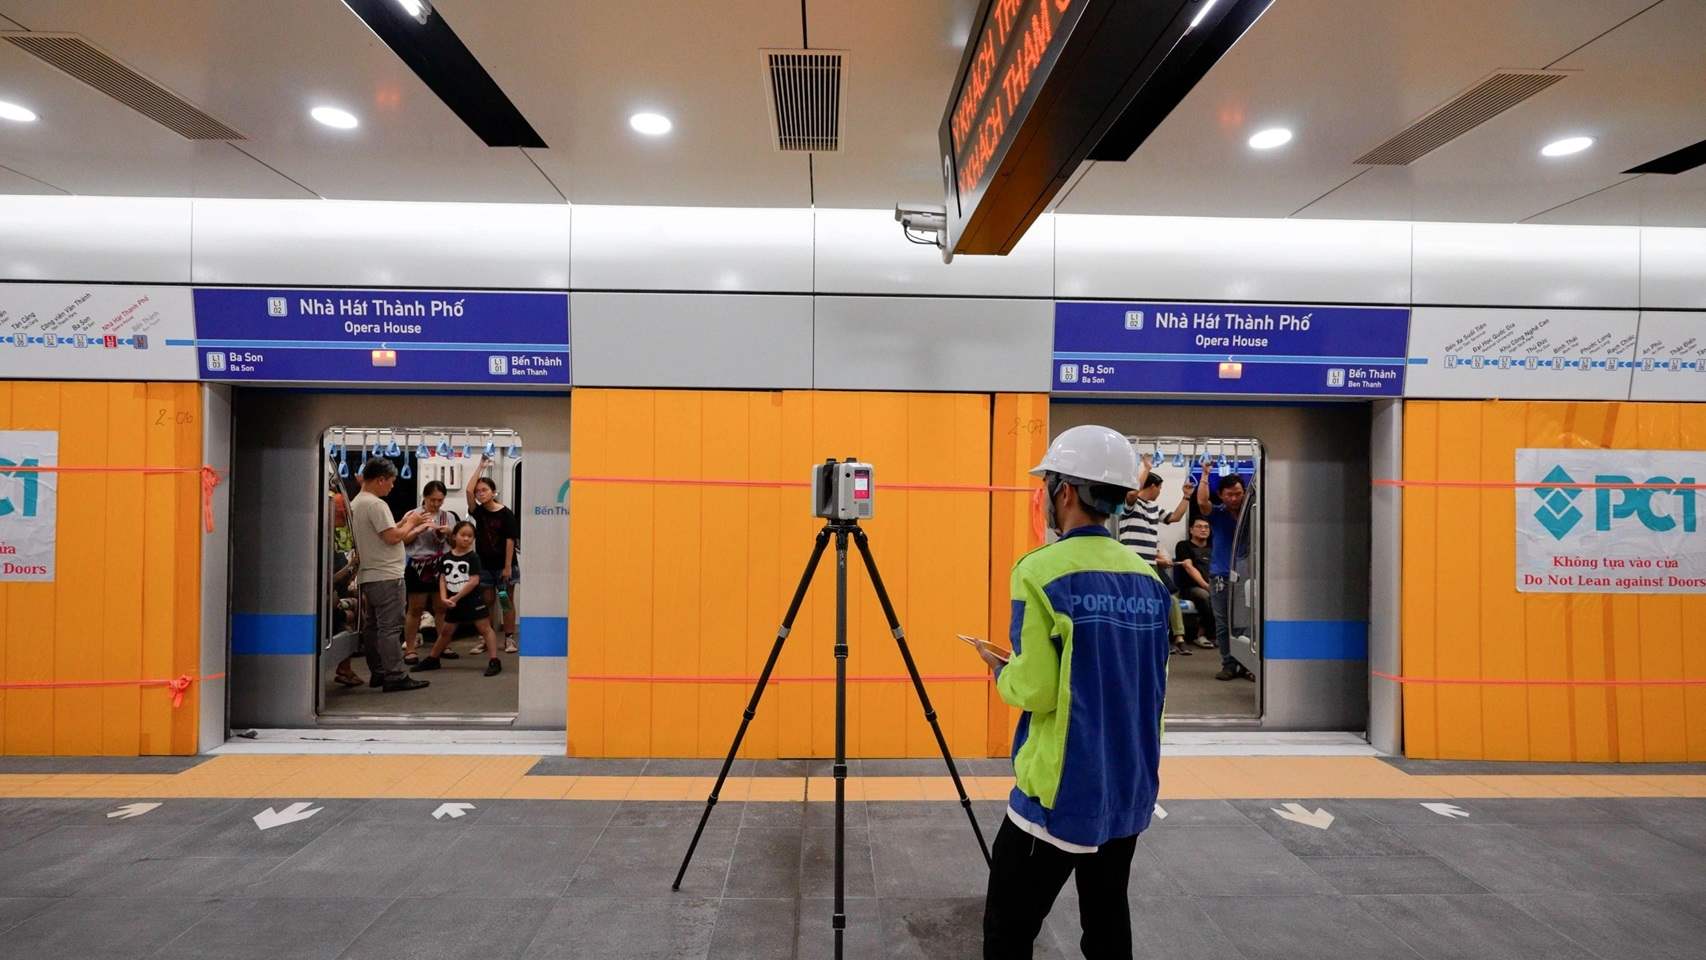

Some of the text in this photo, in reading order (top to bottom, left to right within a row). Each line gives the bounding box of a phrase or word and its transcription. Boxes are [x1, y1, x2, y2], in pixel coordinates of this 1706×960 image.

[300, 297, 465, 317] Nhà Hát Thành Phố
[1156, 312, 1313, 331] Nhà Hát Thành Phố
[344, 321, 422, 336] Opera House
[1195, 334, 1269, 348] Opera House
[229, 352, 263, 362] Ba Son
[511, 355, 562, 367] Bến Thành
[230, 364, 255, 373] Ba Son
[511, 368, 548, 376] Ben Thanh
[1082, 364, 1115, 375] Ba Son
[1349, 368, 1397, 380] Bến Thành
[1092, 376, 1105, 384] Son
[1348, 380, 1382, 388] Ben Thanh
[1595, 475, 1697, 533] PC1
[3, 562, 47, 575] Doors
[1553, 556, 1598, 570] Không
[1629, 556, 1652, 568] vào
[1524, 574, 1706, 589] Do Not Lean against Doors
